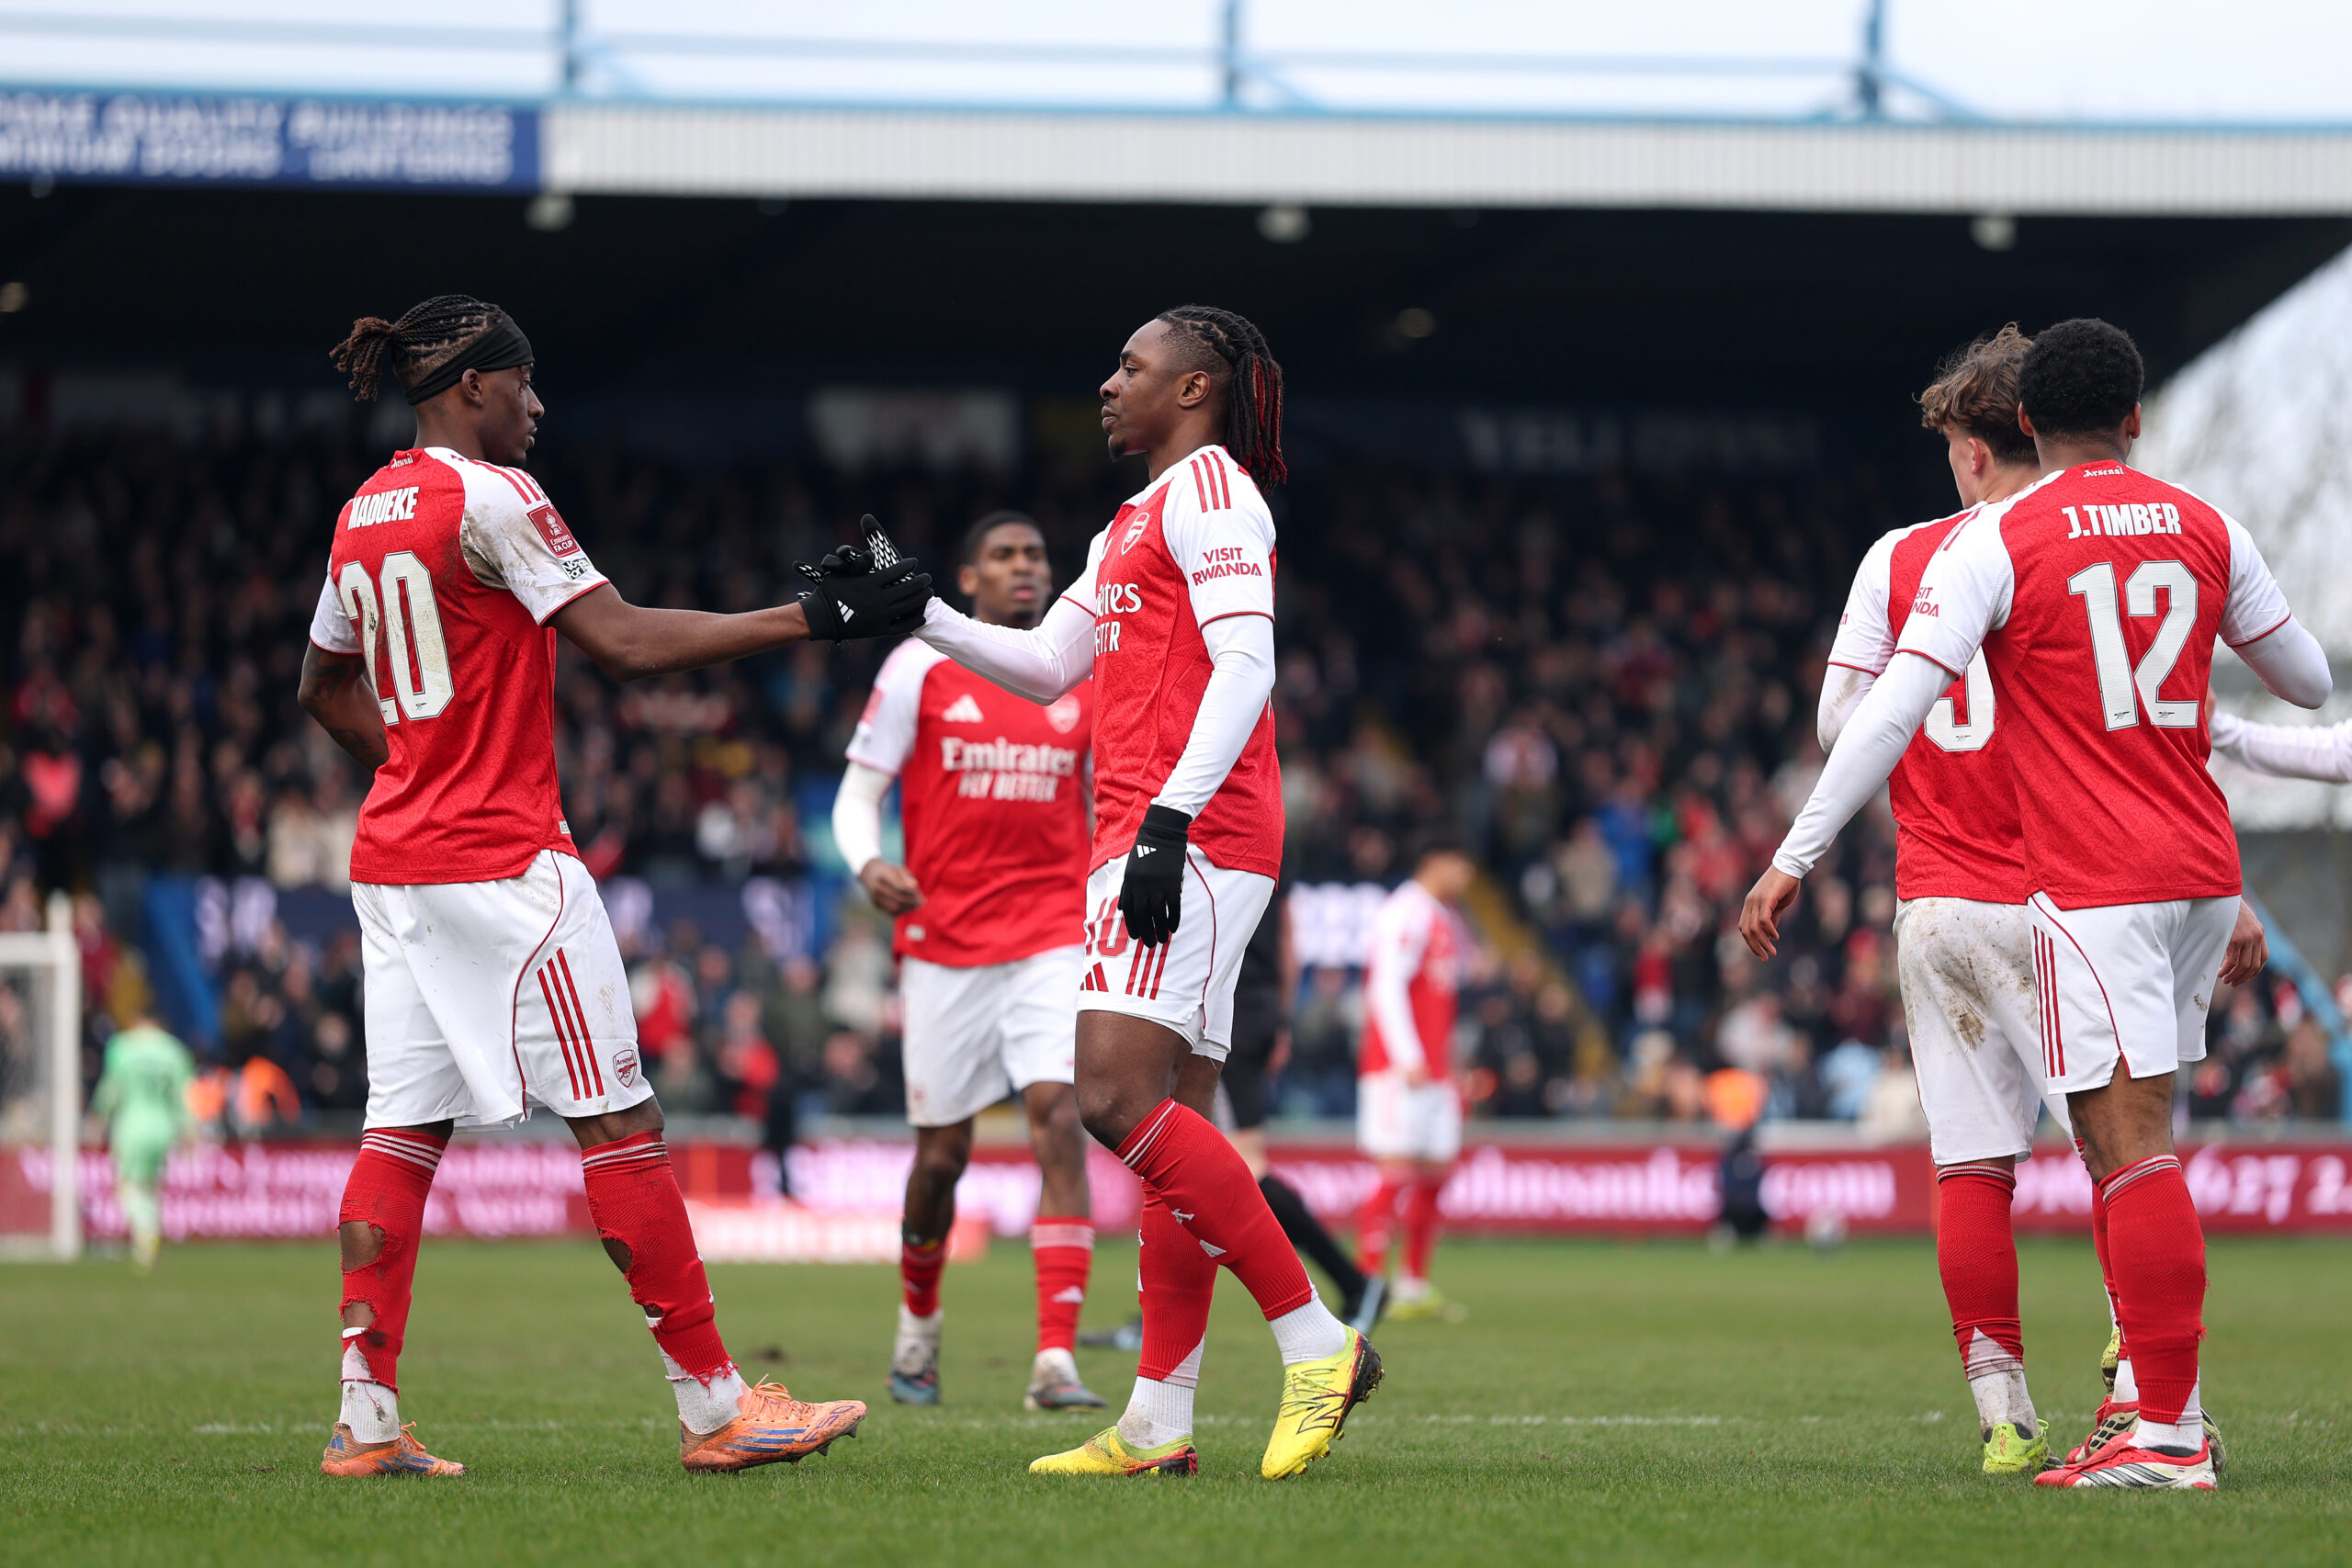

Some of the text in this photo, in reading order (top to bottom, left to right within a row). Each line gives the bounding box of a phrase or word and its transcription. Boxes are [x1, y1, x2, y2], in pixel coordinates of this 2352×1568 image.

[390, 452, 413, 469] Arsenal
[2083, 465, 2124, 478] Arsenal
[2061, 502, 2182, 540] J.TIMBER
[549, 535, 571, 545] Emirates
[553, 539, 573, 553] FA CUP
[1203, 547, 1243, 564] VISIT
[1192, 562, 1262, 586] RWANDA
[1096, 579, 1143, 619] ates
[1916, 587, 1934, 599] SIT
[1911, 601, 1939, 617] NDA
[339, 550, 455, 727] 20
[2067, 559, 2199, 732] 12
[941, 737, 1078, 776] Emirates
